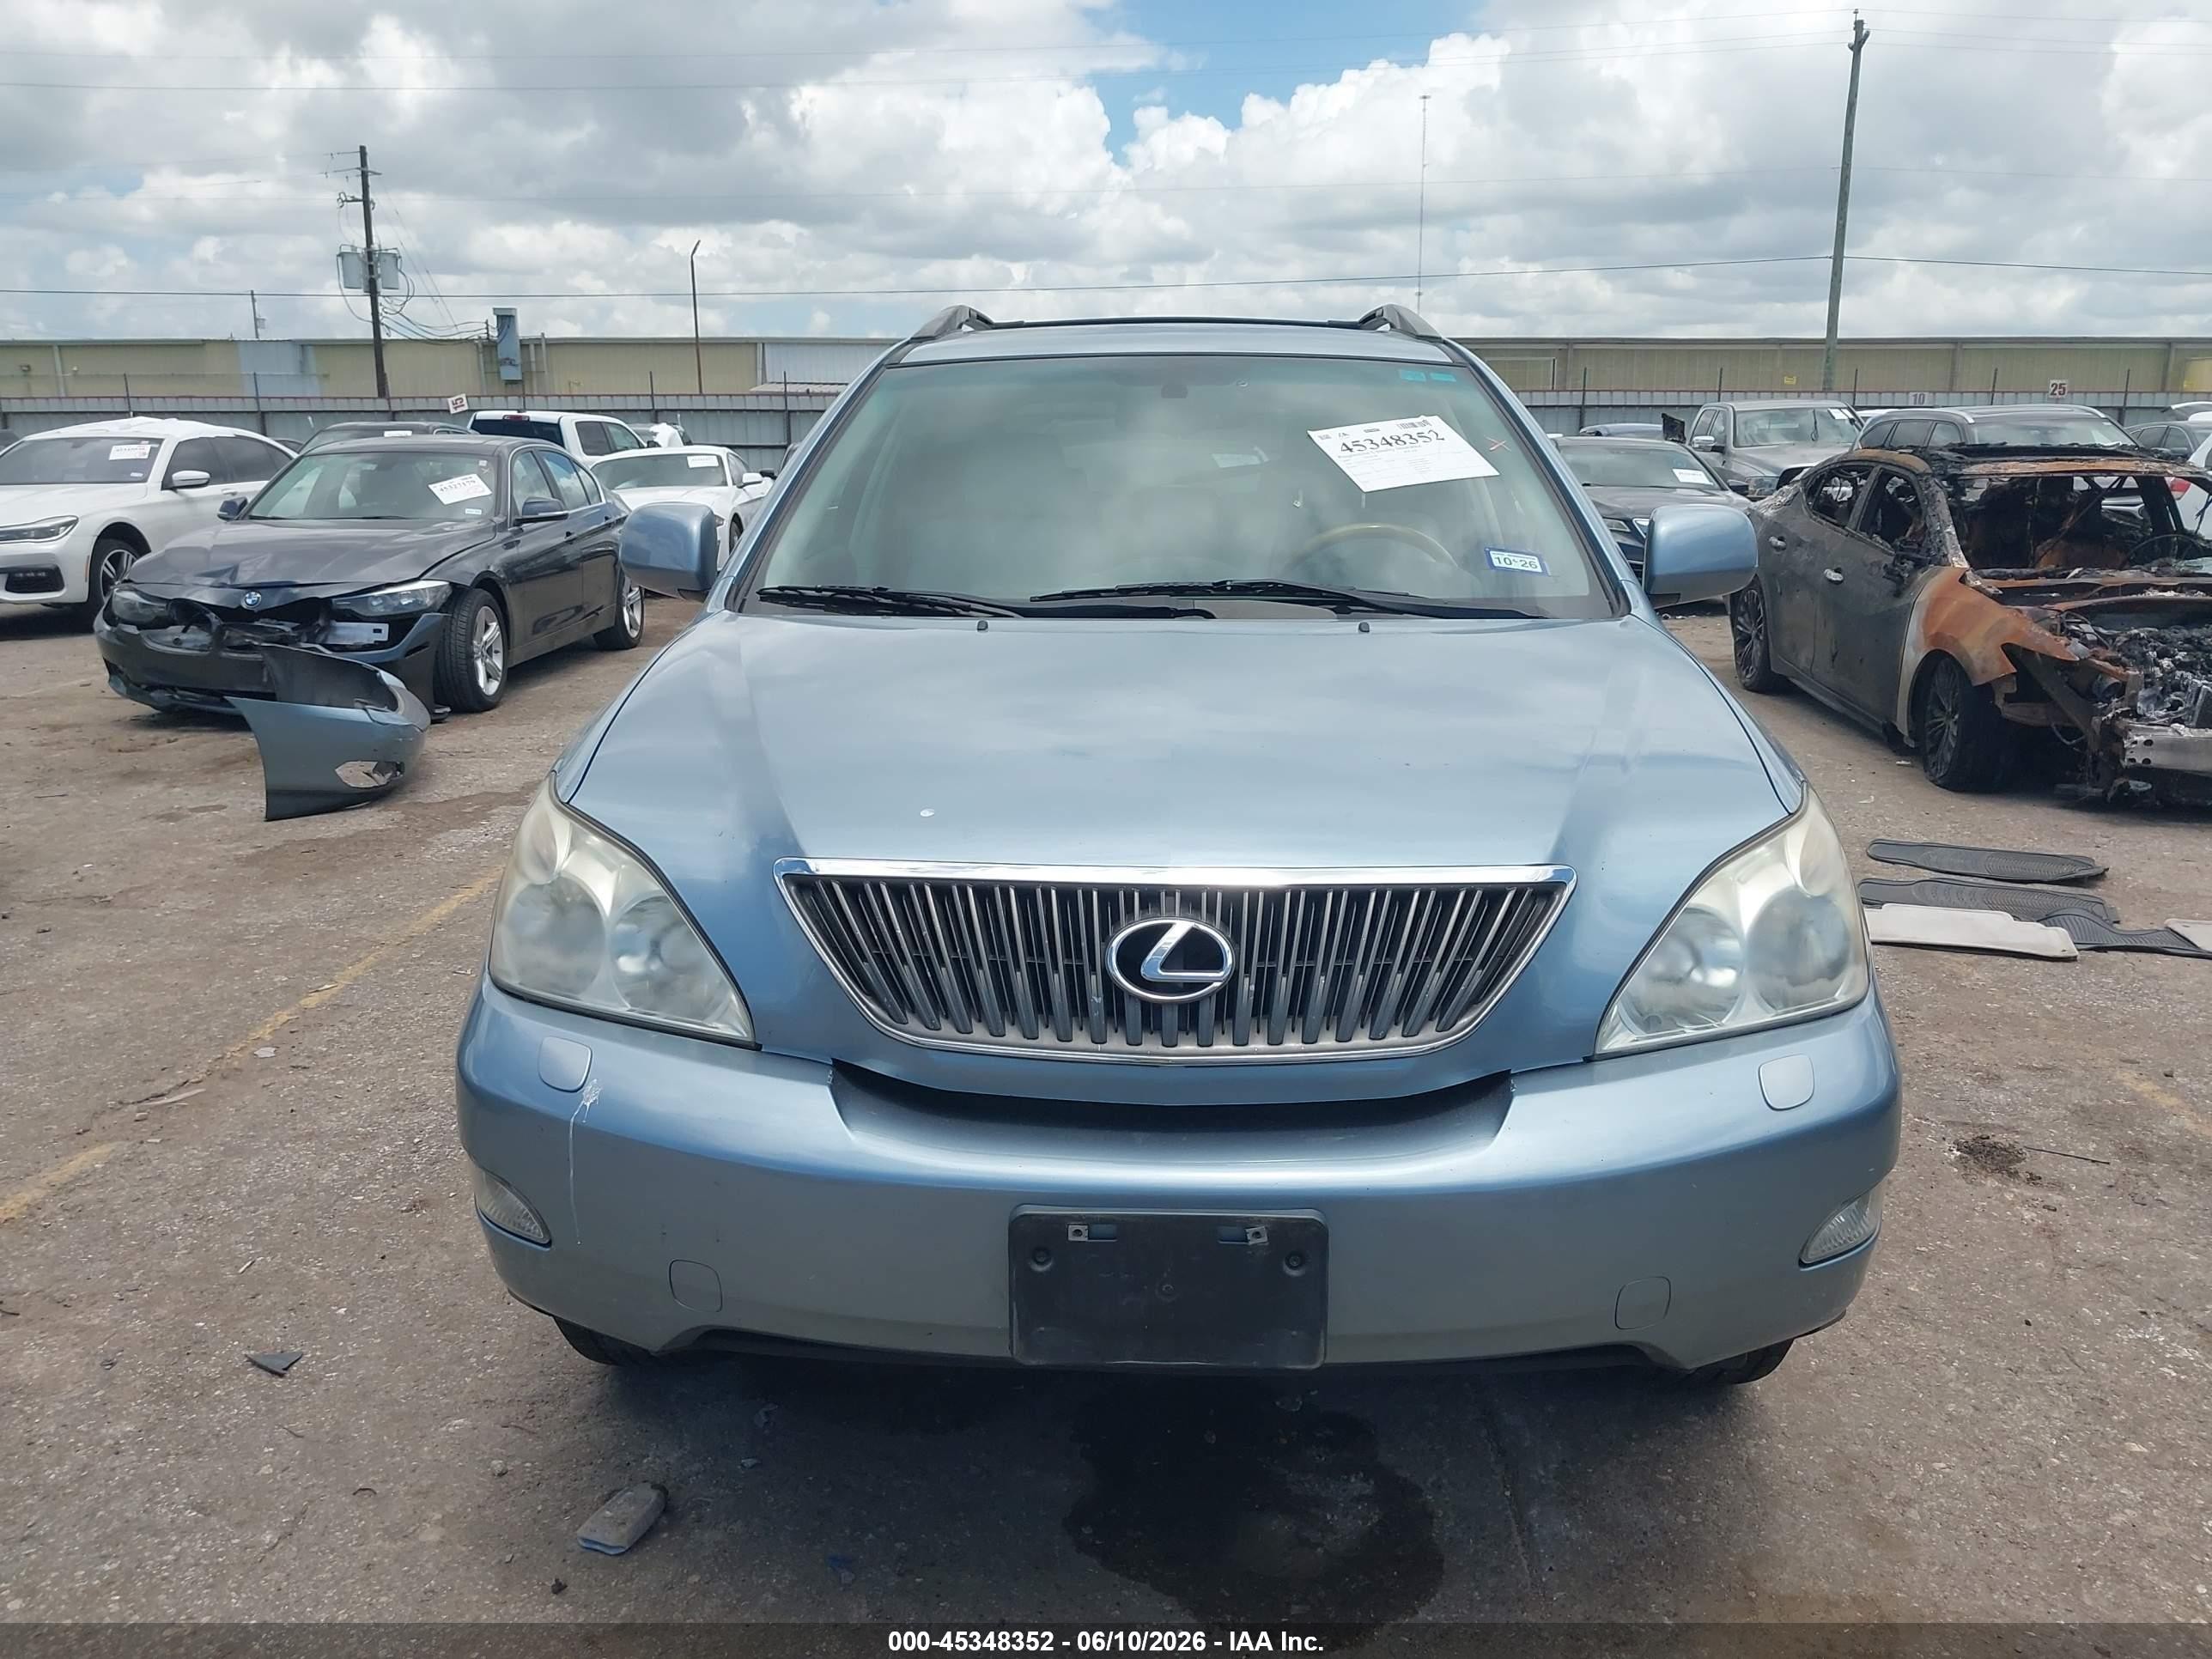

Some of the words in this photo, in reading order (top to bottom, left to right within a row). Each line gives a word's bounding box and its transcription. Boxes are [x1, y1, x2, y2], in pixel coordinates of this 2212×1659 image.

[2050, 382, 2066, 396] 25
[452, 397, 465, 411] 15
[1911, 392, 1925, 405] 10
[1340, 429, 1445, 453] 45348352
